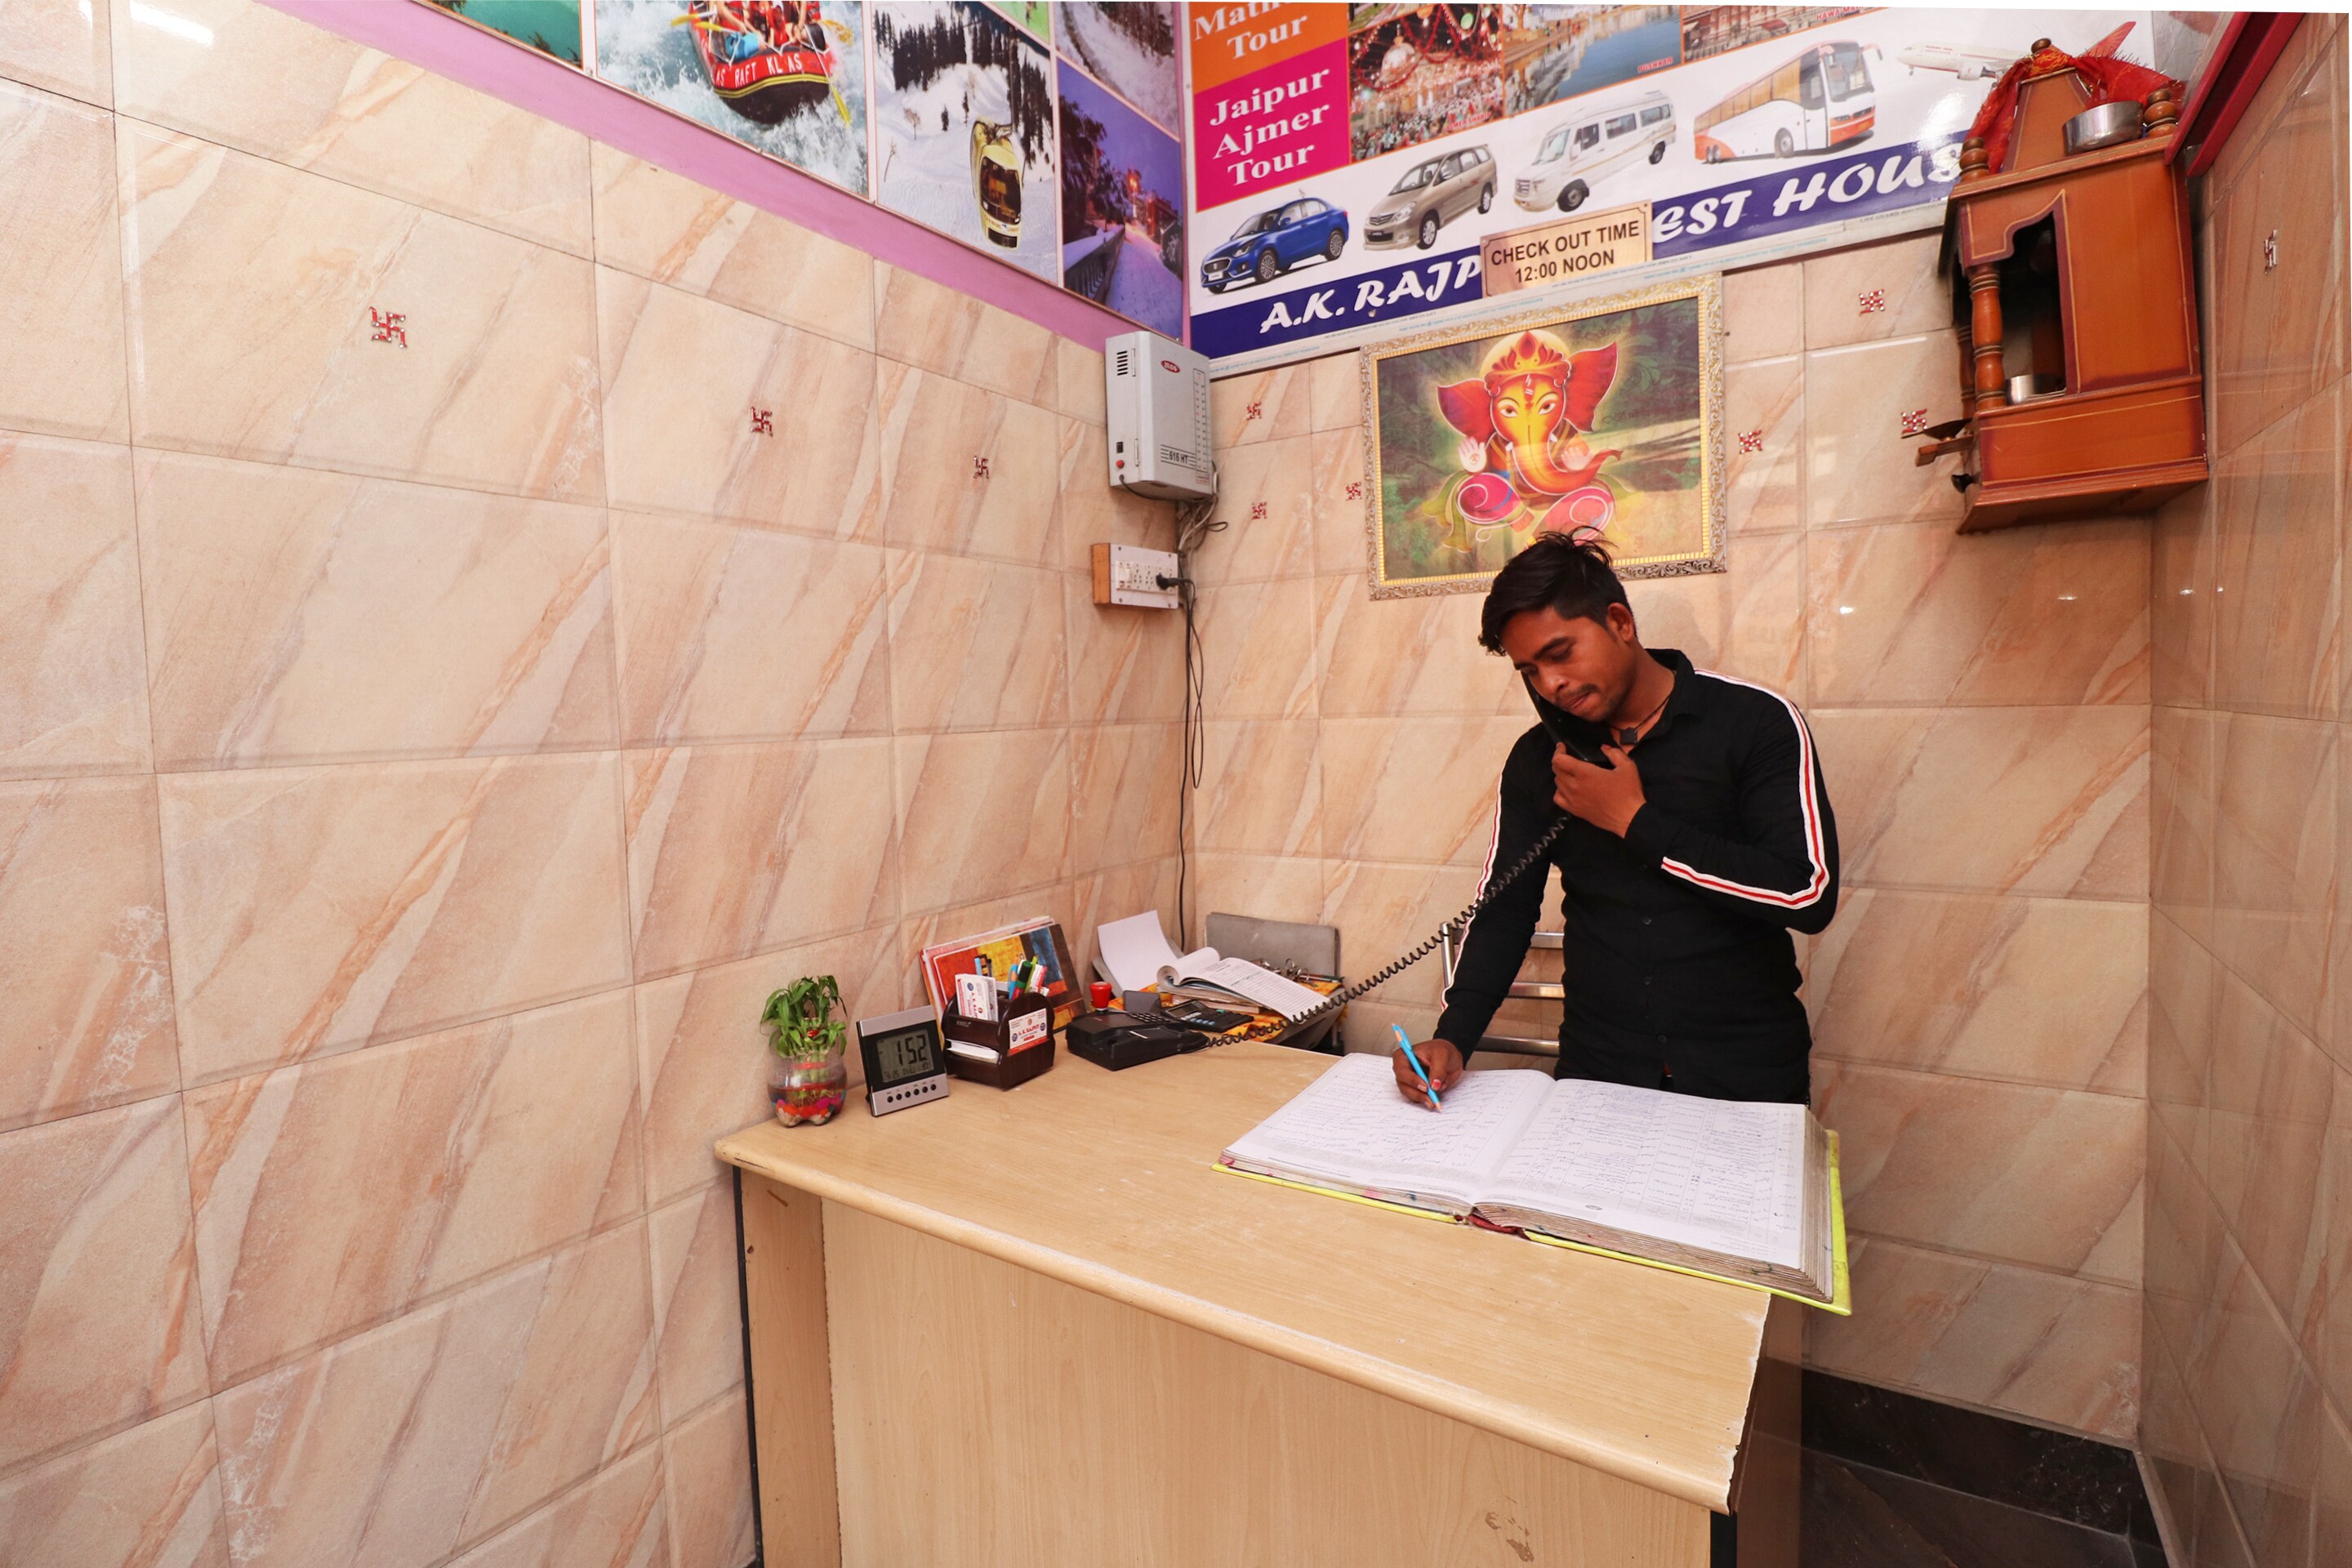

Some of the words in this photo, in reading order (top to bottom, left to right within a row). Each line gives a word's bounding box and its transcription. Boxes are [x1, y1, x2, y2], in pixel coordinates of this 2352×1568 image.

[1815, 8, 1841, 20] HAWA
[1227, 16, 1308, 60] Tour
[735, 62, 756, 87] RAFT
[1209, 69, 1330, 126] Jaipur
[1213, 105, 1330, 159] Ajmer
[1227, 145, 1315, 186] Tour
[1491, 239, 1550, 265] CHECK
[1555, 230, 1591, 252] OUT
[1596, 220, 1639, 243] TIME
[1515, 261, 1557, 283] 12:00
[1563, 249, 1615, 274] NOON
[1259, 289, 1345, 333] A.K.
